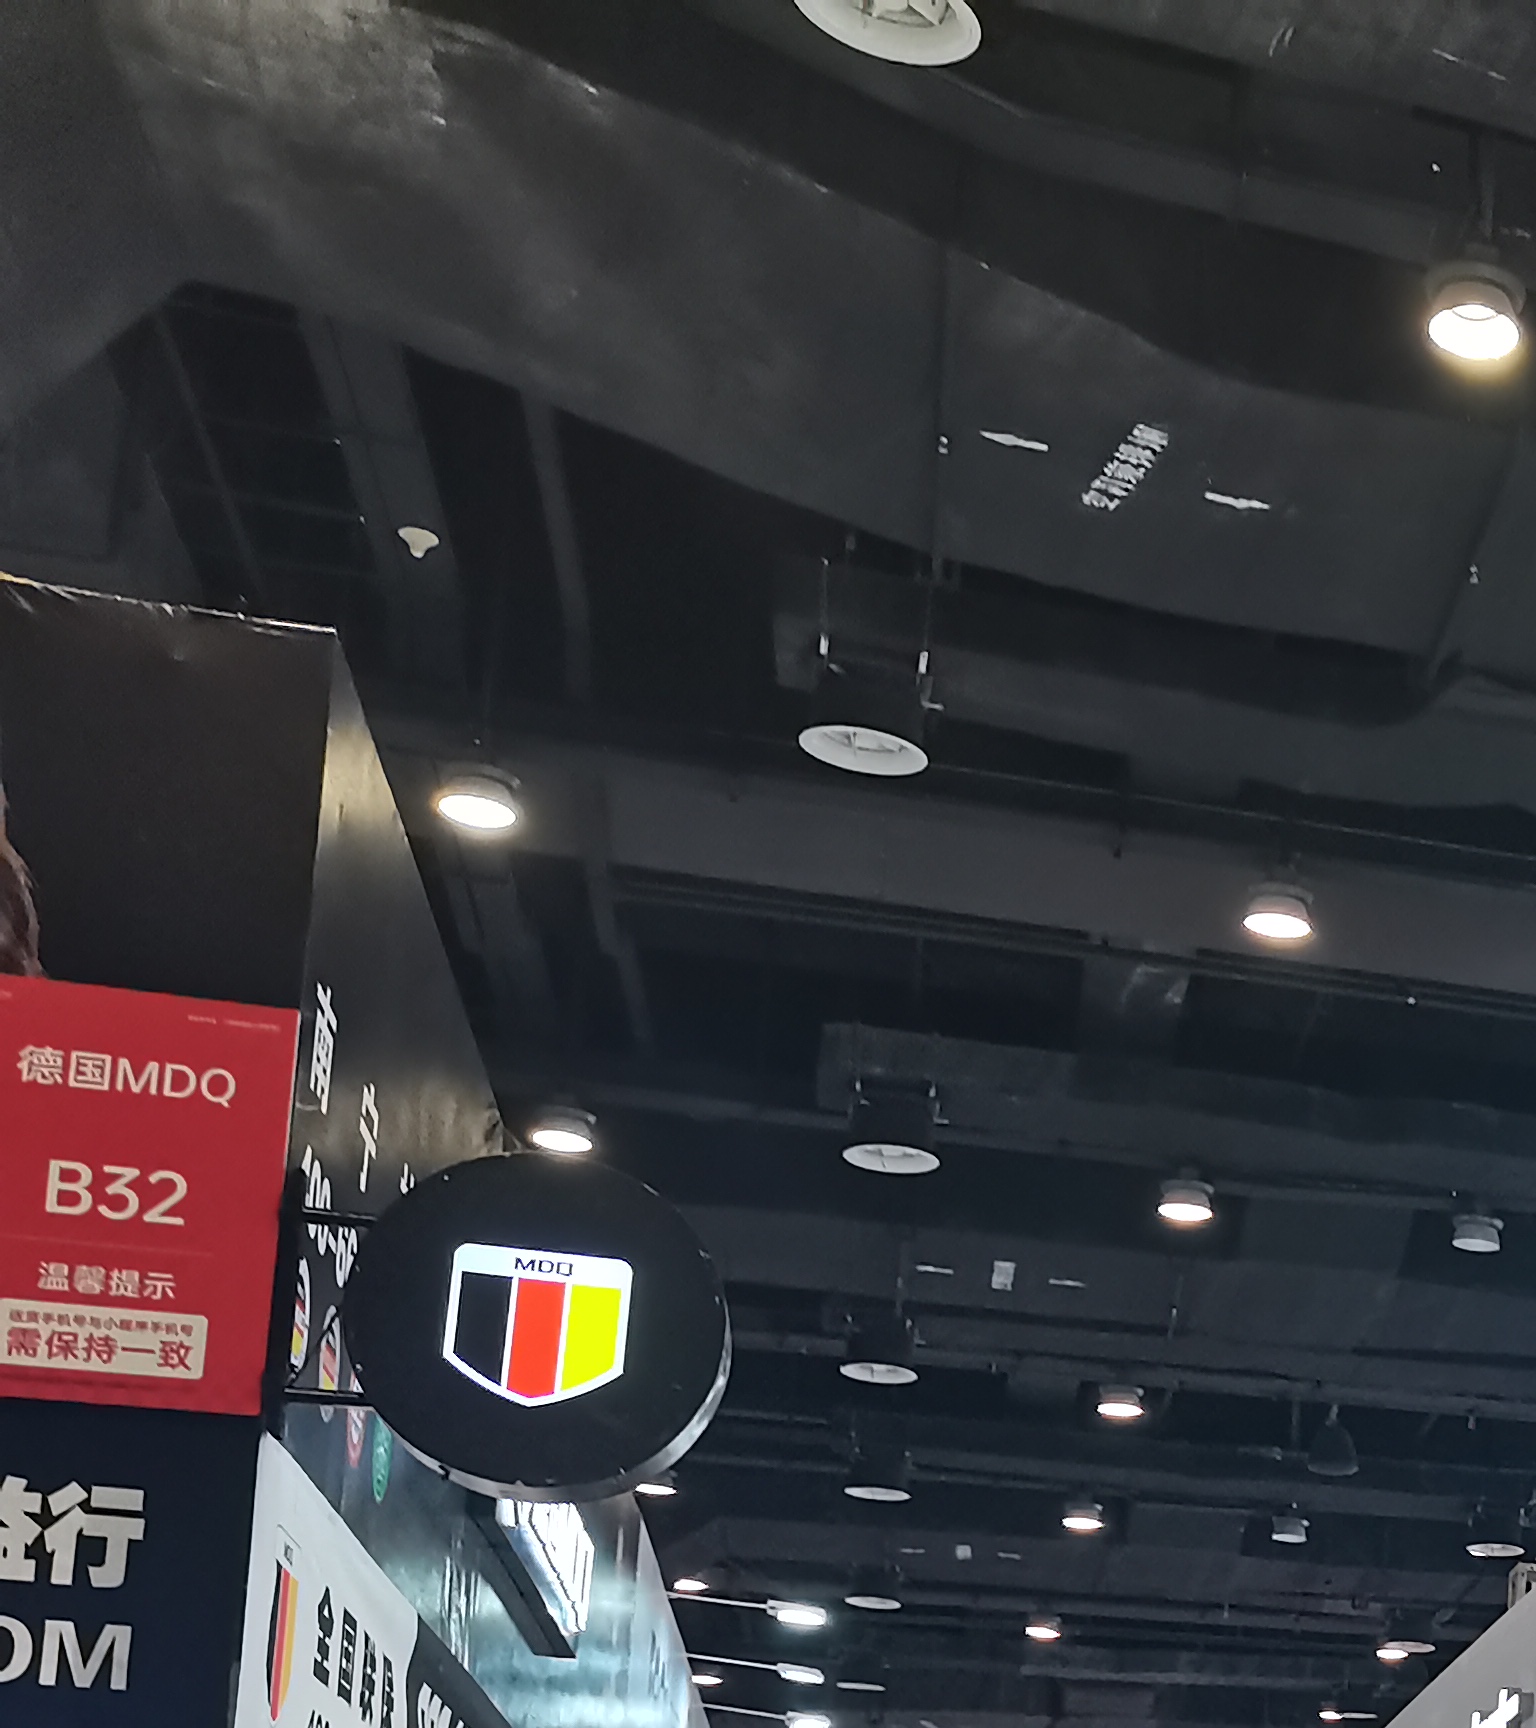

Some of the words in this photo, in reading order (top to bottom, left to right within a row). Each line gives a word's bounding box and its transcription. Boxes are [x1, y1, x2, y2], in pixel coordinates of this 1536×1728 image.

[16, 1044, 237, 1108] 德国MDQ
[44, 1158, 188, 1226] B32
[37, 1260, 176, 1300] 温馨提示
[514, 1256, 574, 1277] MDQ
[6, 1326, 194, 1372] 需保持一致
